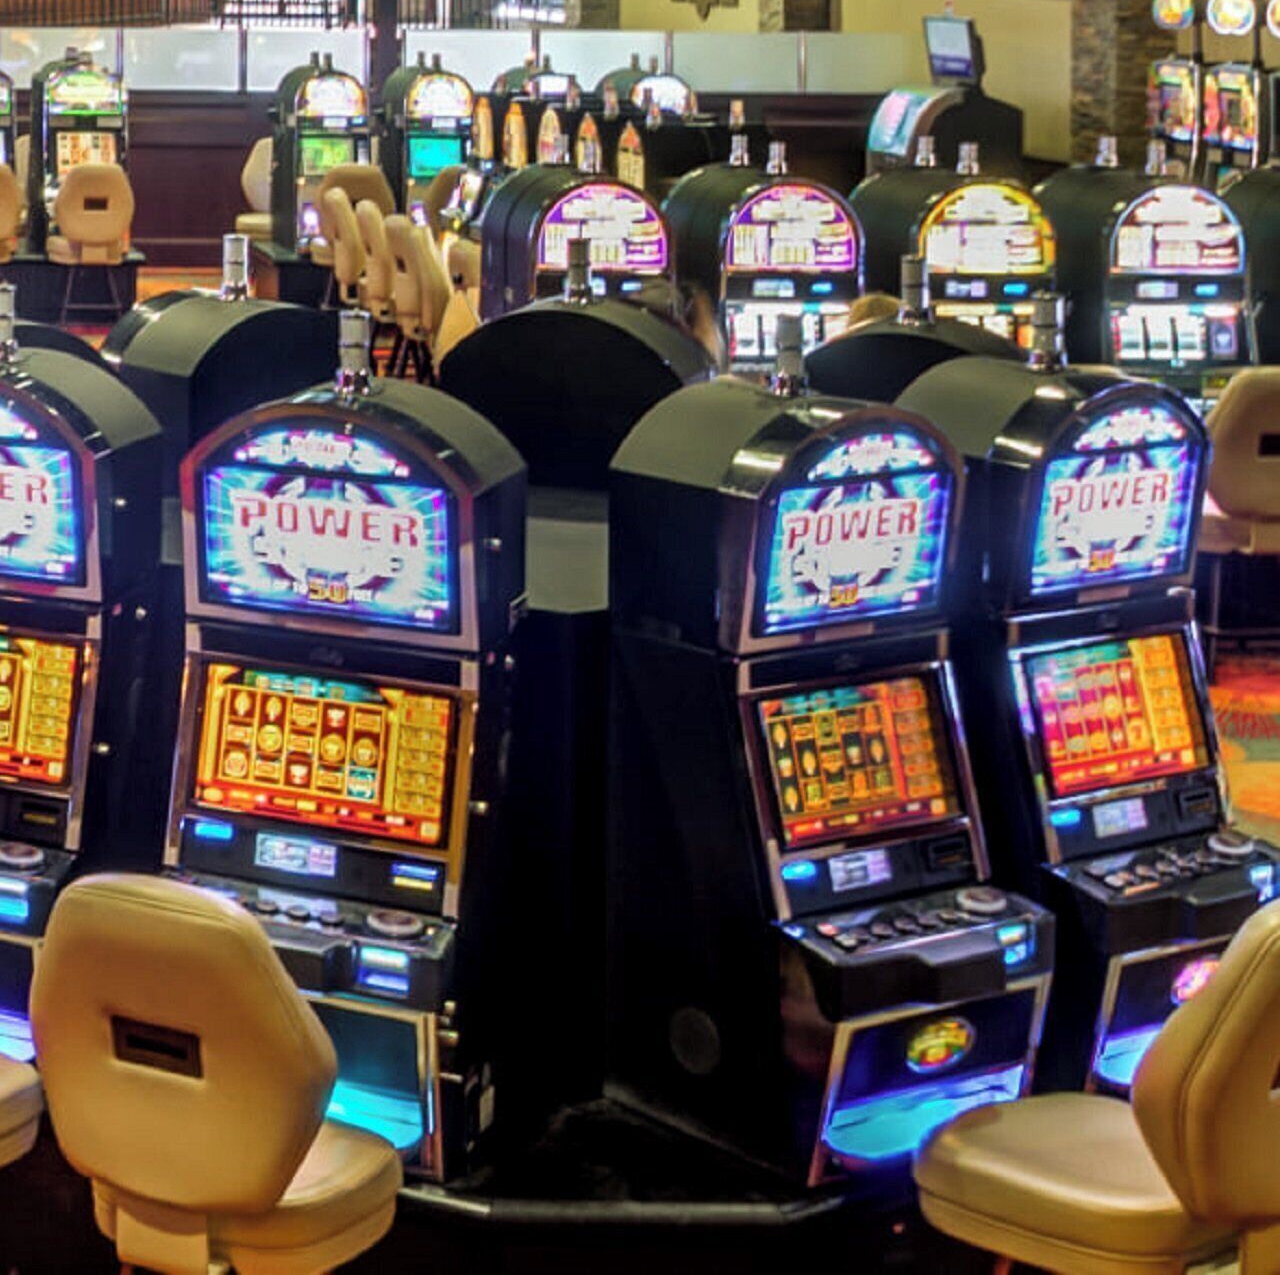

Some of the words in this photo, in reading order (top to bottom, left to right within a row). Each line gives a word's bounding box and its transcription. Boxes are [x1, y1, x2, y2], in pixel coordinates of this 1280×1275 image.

[1053, 473, 1169, 517] POWER
[235, 498, 419, 548] POWER
[786, 502, 918, 551] POWER
[308, 579, 349, 603] 50
